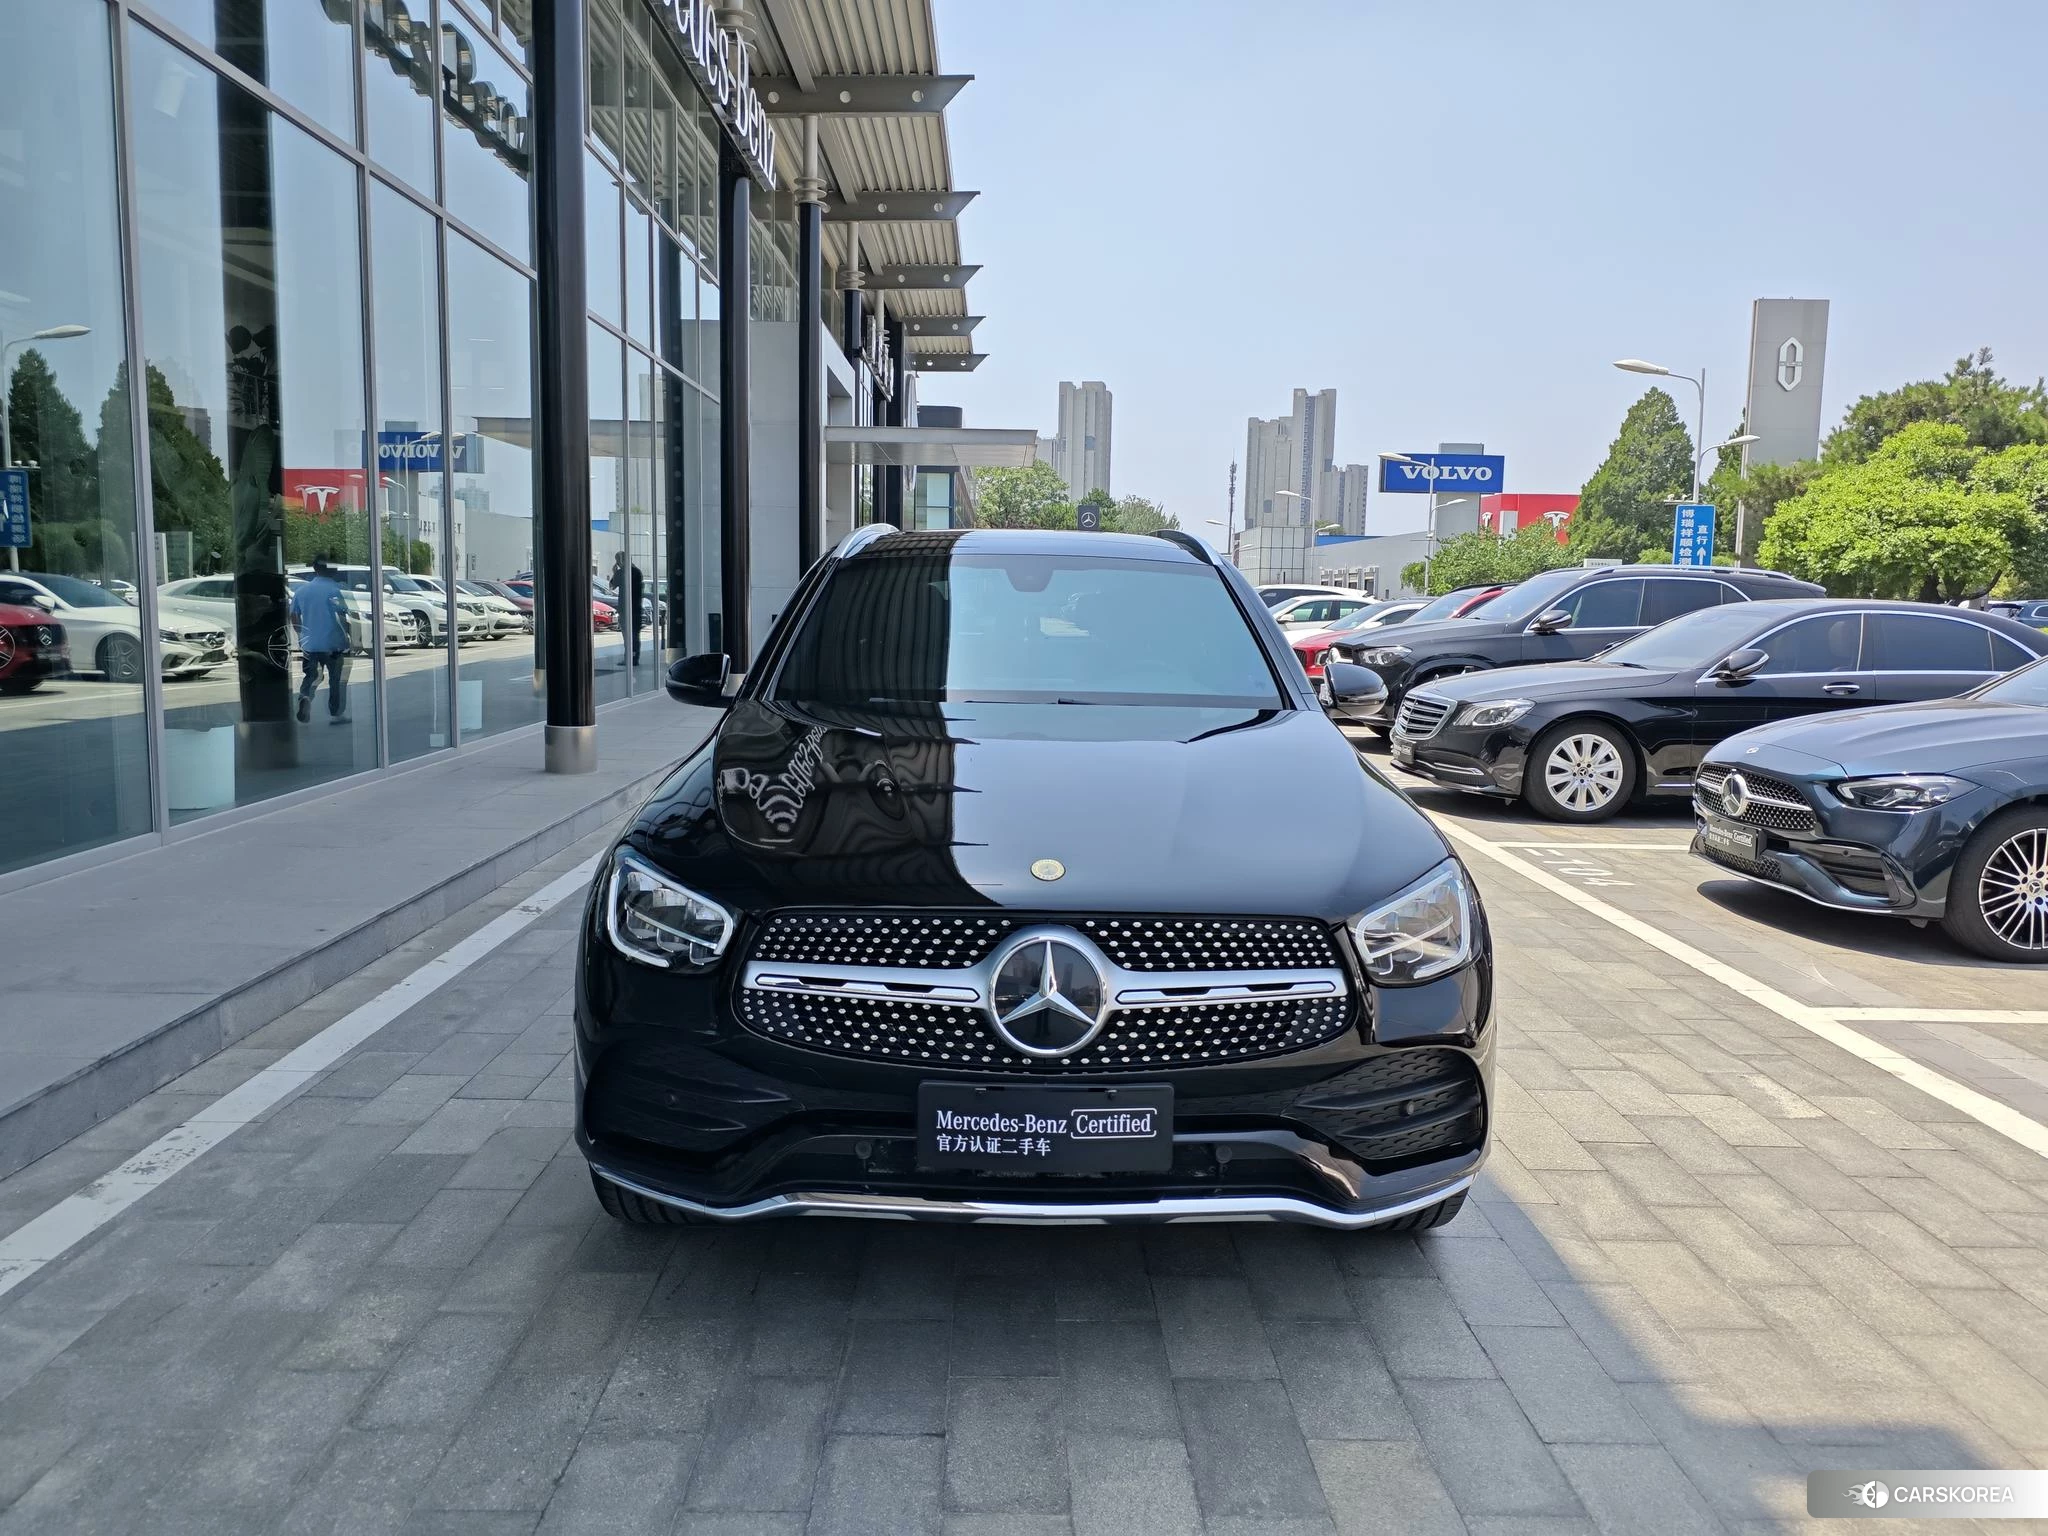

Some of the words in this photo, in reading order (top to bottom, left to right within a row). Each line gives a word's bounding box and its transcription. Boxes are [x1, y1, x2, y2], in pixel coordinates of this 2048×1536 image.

[1400, 465, 1493, 481] VOLVO
[1696, 524, 1709, 545] 直行
[936, 1110, 1067, 1134] Mercedes-Benz
[1075, 1114, 1152, 1134] Certified
[936, 1134, 1052, 1157] 官方认证二手车
